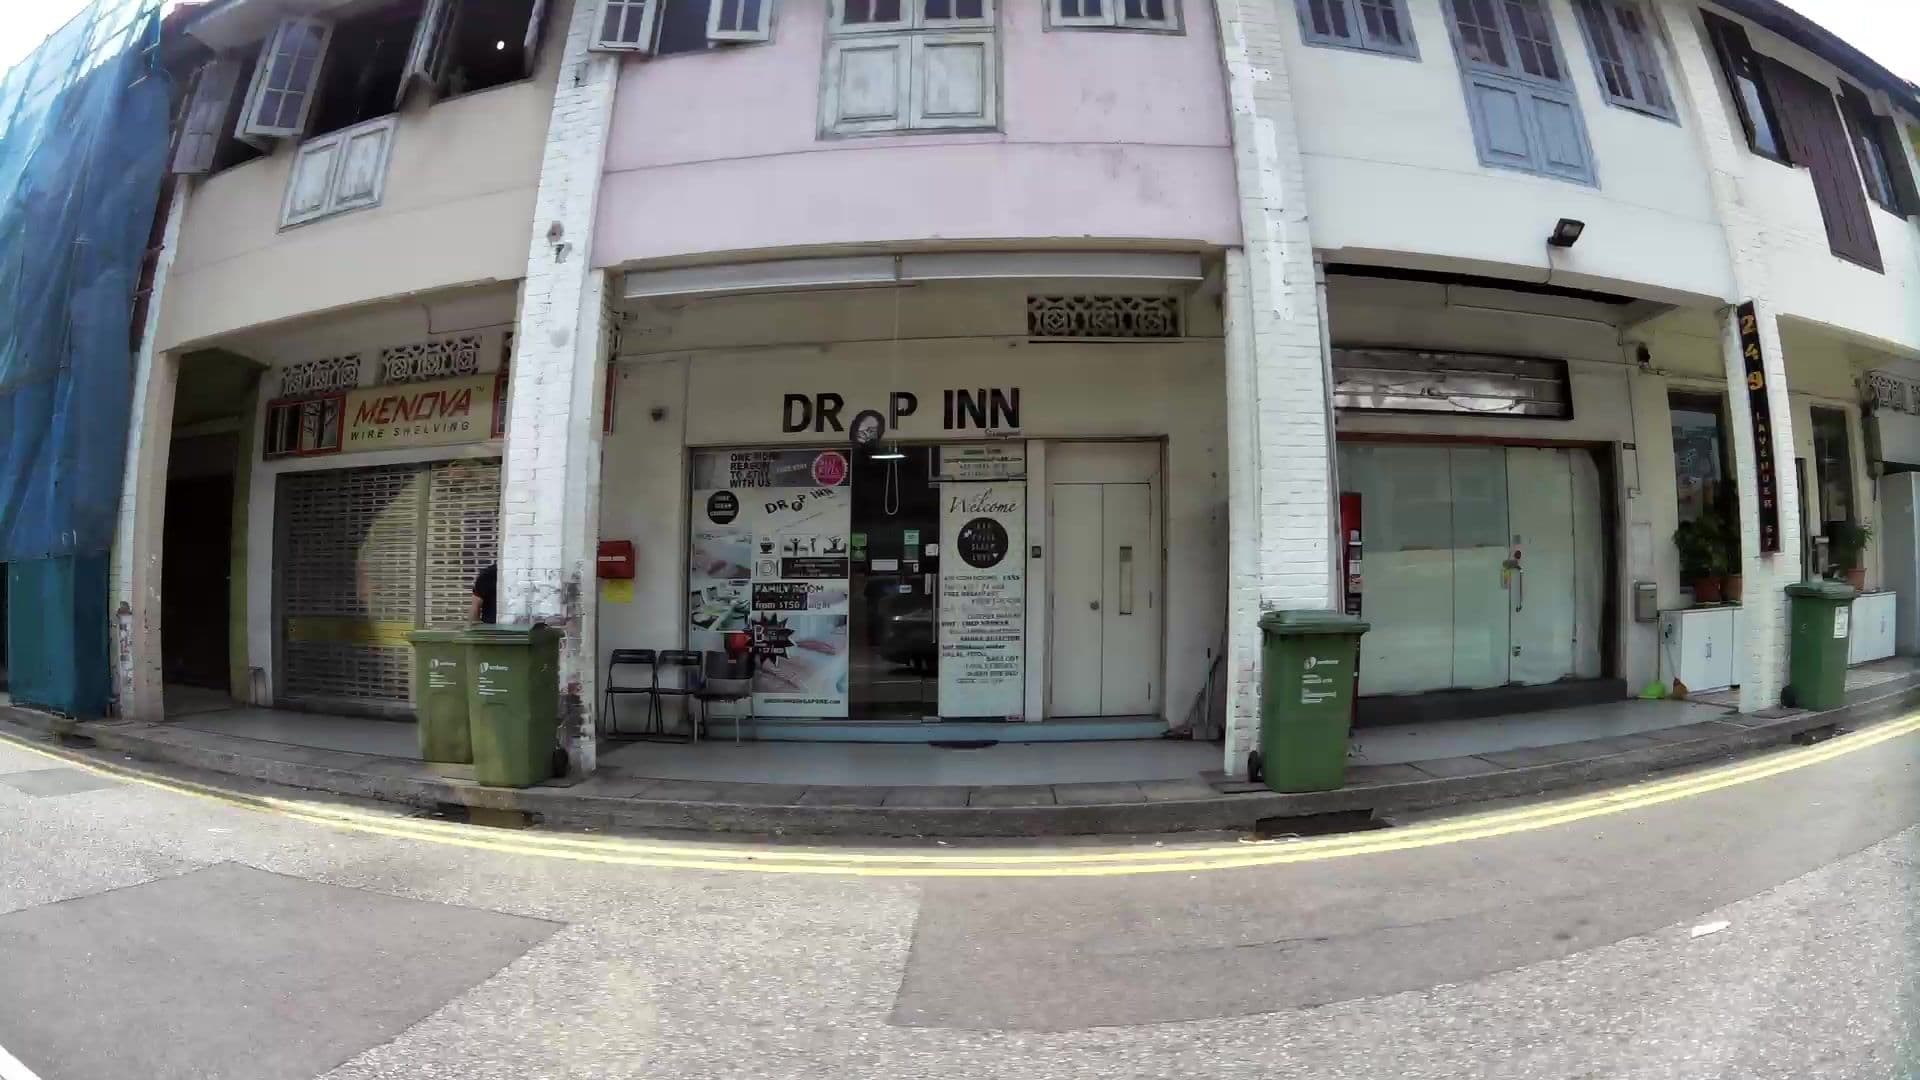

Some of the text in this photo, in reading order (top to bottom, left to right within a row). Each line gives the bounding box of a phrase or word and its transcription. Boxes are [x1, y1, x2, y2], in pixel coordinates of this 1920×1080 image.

[1742, 314, 1764, 390] 249
[353, 387, 472, 428] MENOVA
[783, 387, 1020, 446] DROP INN
[351, 420, 470, 441] WIRE SHELVING
[730, 479, 772, 488] WITH US
[765, 494, 806, 515] DROP
[948, 487, 1018, 513] Welcome
[754, 586, 790, 595] FAMILY
[755, 600, 776, 609] from
